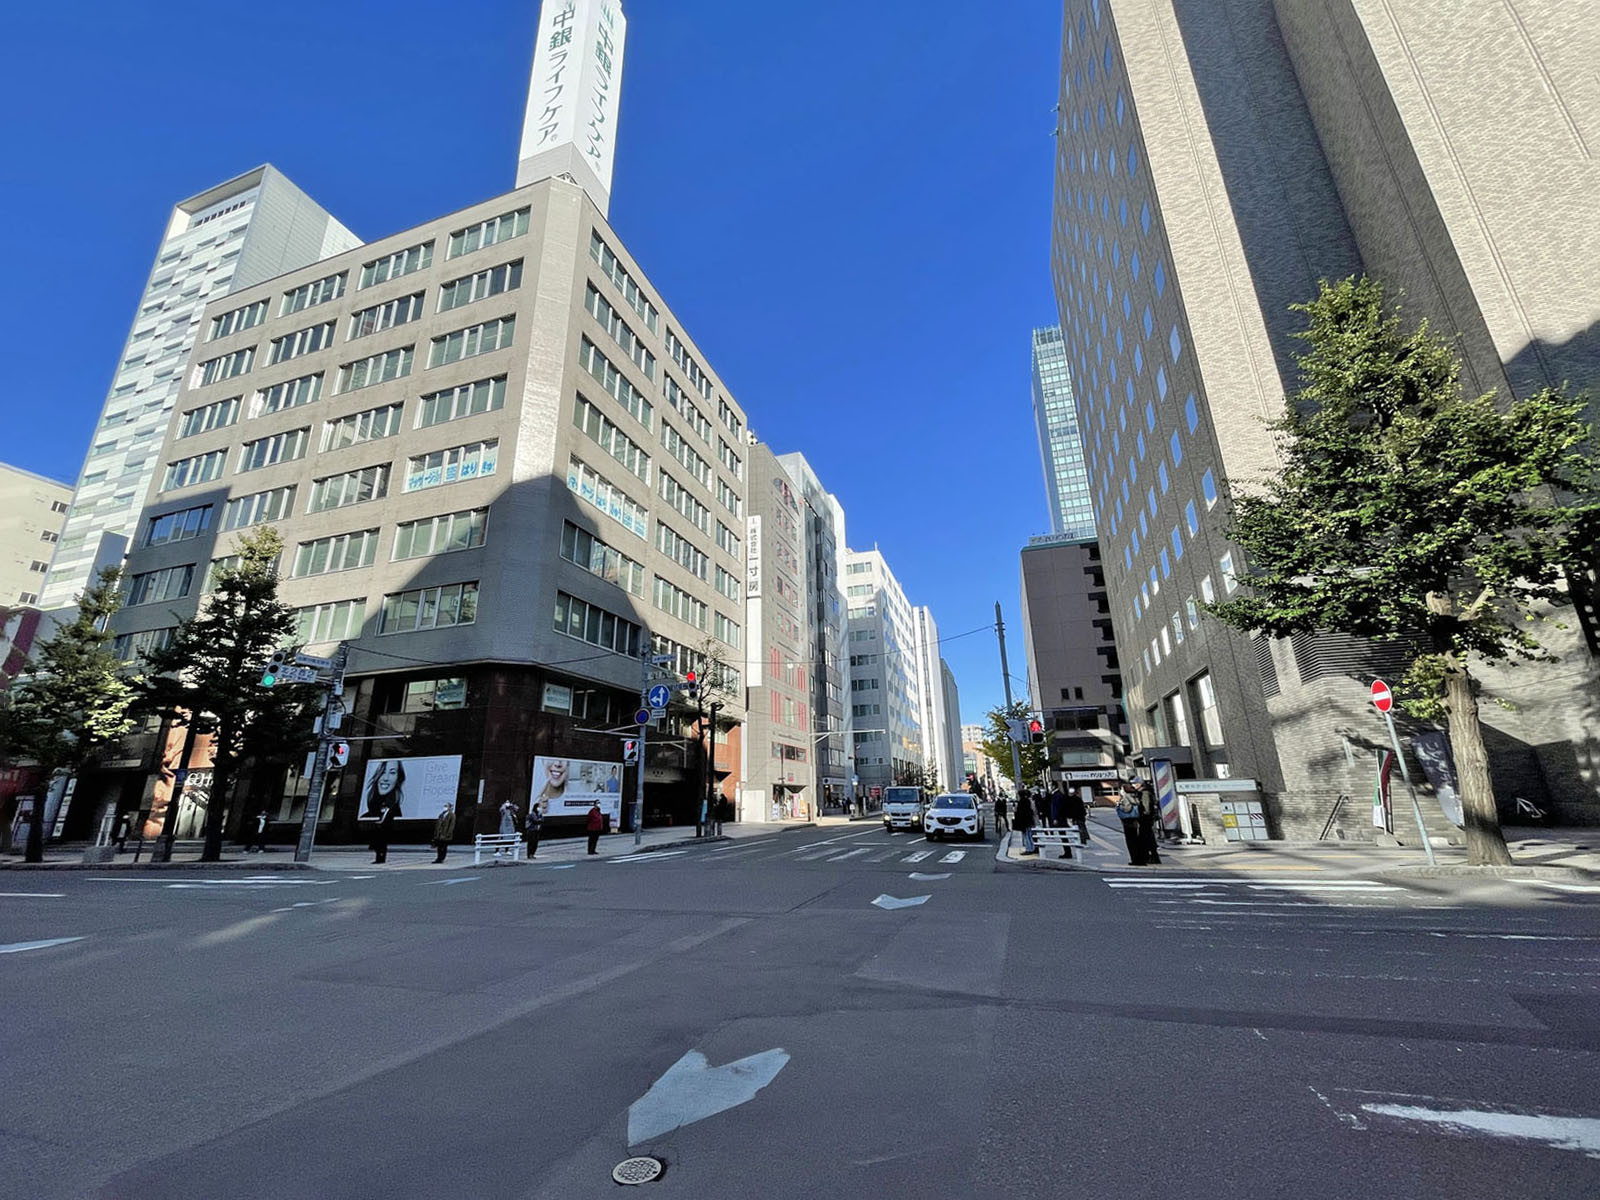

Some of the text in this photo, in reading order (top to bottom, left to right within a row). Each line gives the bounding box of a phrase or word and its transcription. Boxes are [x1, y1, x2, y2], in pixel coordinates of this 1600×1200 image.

[537, 9, 575, 146] 中銀ライフケア
[586, 21, 613, 159] 中銀ライフケア
